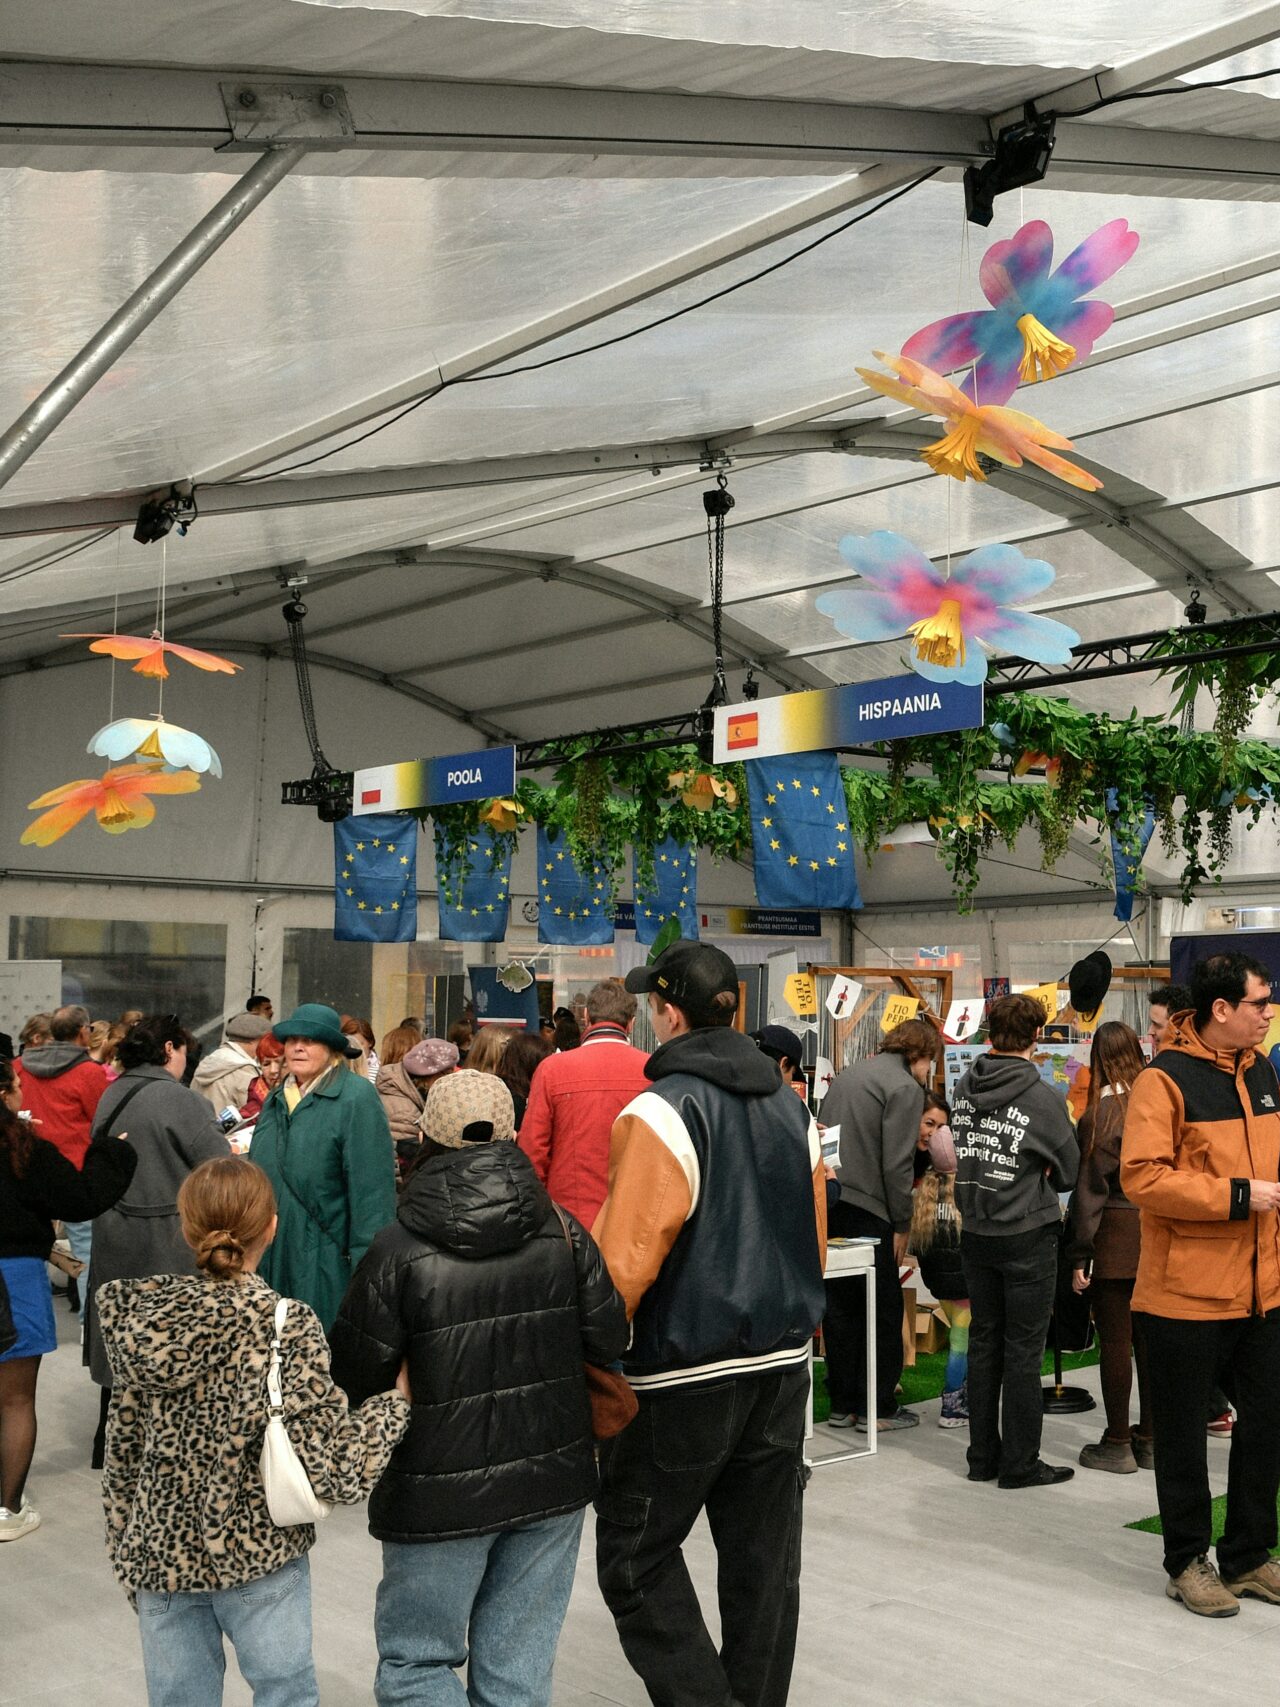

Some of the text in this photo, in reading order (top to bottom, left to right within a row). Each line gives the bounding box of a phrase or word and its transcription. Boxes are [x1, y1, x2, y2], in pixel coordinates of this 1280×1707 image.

[859, 692, 942, 721] HISPAANIA
[447, 767, 483, 787] POOLA
[794, 979, 808, 1010] PEPE
[803, 981, 813, 1005] TIO
[892, 1004, 909, 1014] TIO
[979, 1115, 1026, 1141] slaying
[1006, 1106, 1030, 1126] the
[966, 1130, 1002, 1150] game,
[1009, 1139, 1019, 1155] &
[991, 1152, 1020, 1169] real.
